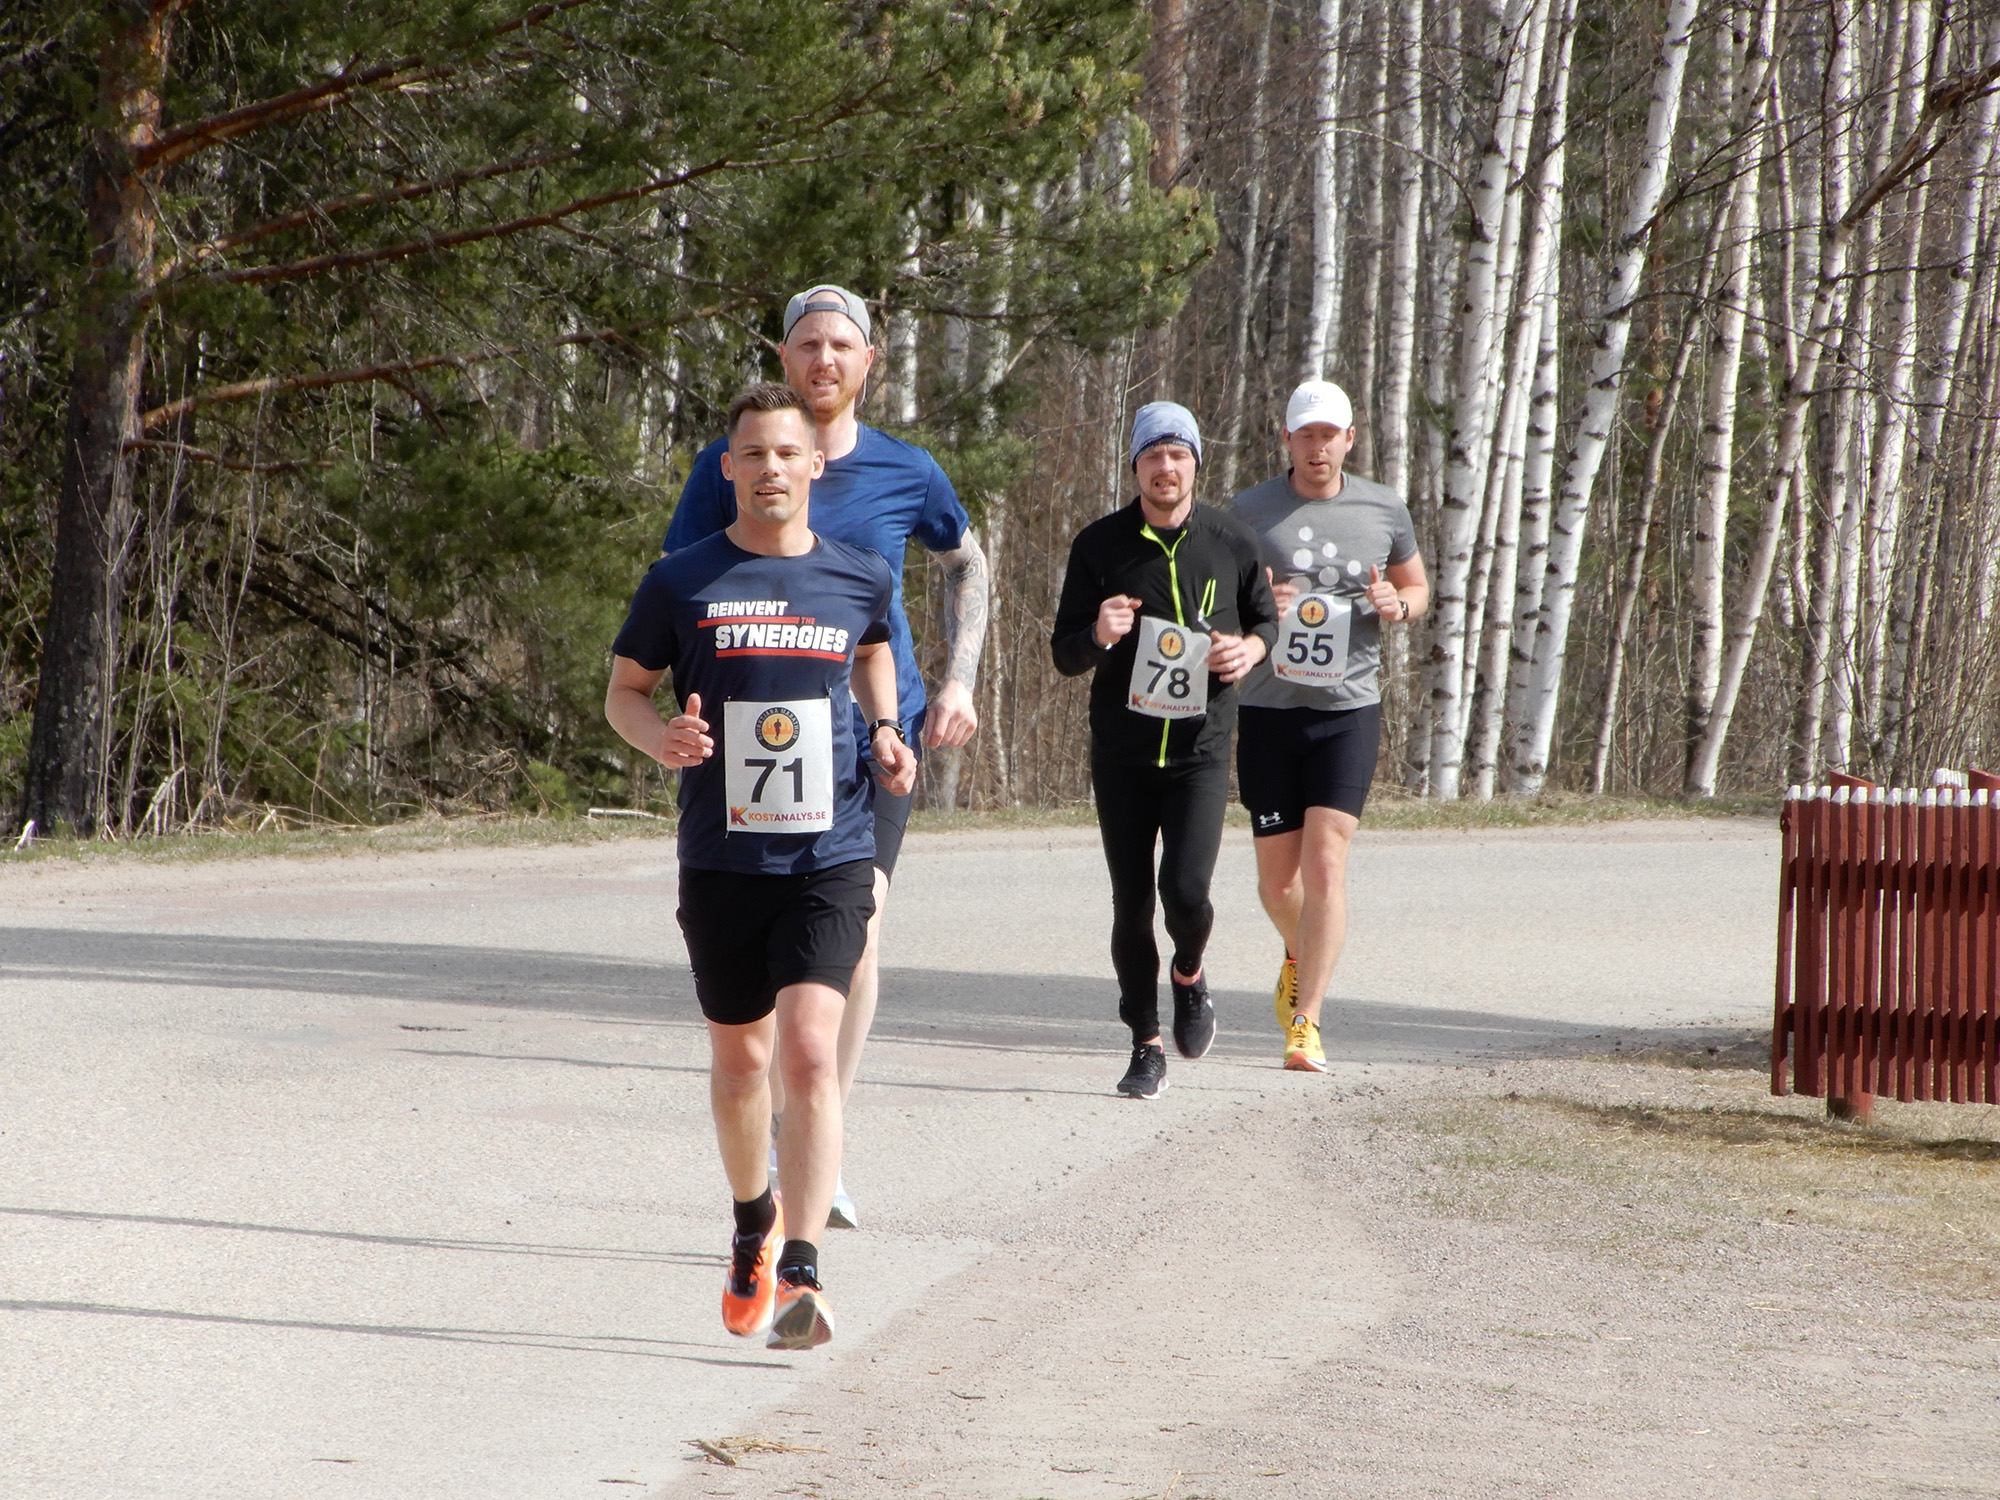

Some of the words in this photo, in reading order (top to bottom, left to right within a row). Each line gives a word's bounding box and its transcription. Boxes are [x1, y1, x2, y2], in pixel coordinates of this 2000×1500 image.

[707, 600, 788, 618] REINVENT
[800, 616, 816, 625] THE
[715, 623, 849, 653] SYNERGIES
[1287, 632, 1334, 666] 55
[1147, 660, 1190, 699] 78
[744, 757, 803, 803] 71
[748, 811, 826, 822] KOSTANALYS.SE
